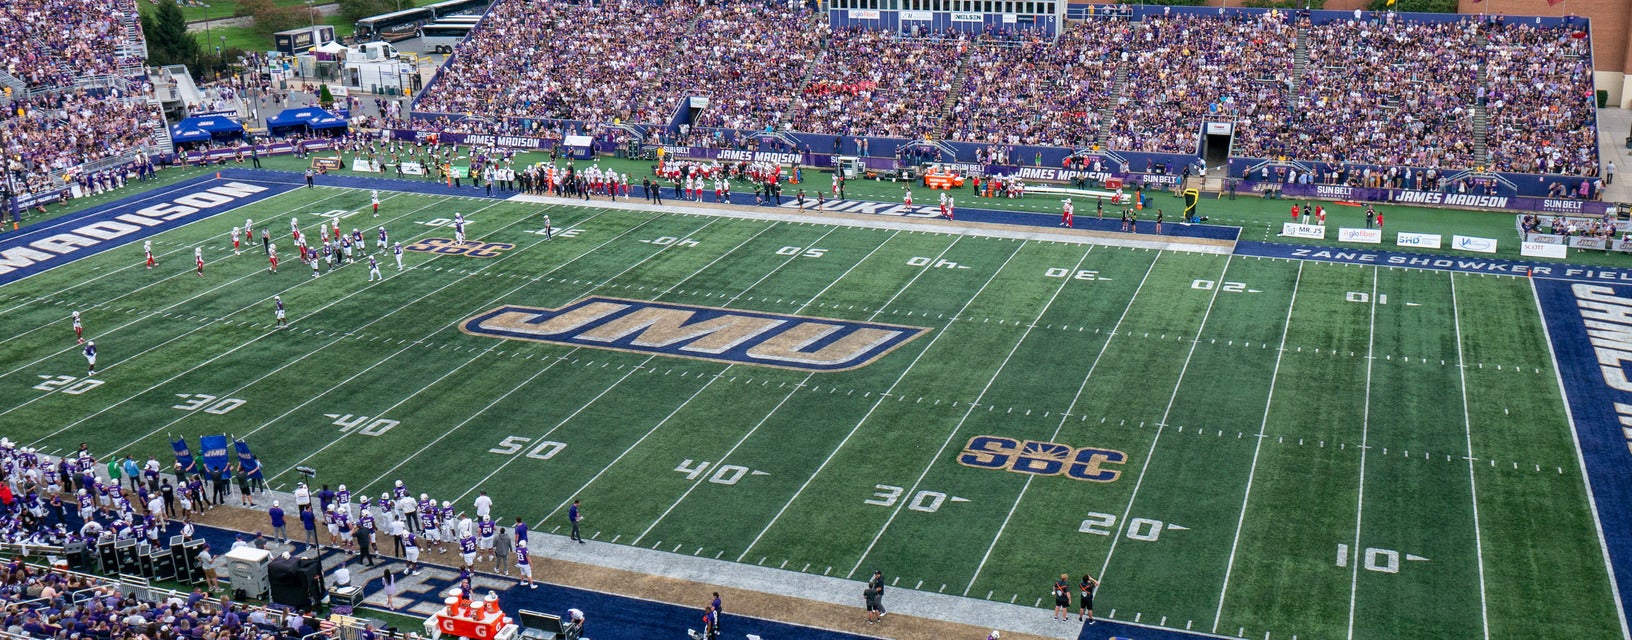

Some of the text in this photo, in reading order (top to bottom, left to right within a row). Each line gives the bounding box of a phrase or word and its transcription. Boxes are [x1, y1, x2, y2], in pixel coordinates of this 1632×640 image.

[464, 134, 540, 148] JAMES MADISON
[717, 150, 802, 164] JAMES MADISON
[1015, 168, 1055, 180] JAMES
[1143, 174, 1176, 184] SUN BELT
[1317, 186, 1334, 194] SUN
[1396, 191, 1508, 208] JAMES MADISON
[1544, 200, 1562, 208] SUN
[0, 181, 270, 275] MADISON
[1291, 248, 1378, 262] ZANE
[1387, 256, 1552, 275] SHOWKER
[474, 300, 908, 367] JMU
[32, 375, 106, 394] 20
[172, 394, 248, 415] 30
[332, 413, 400, 437] 40
[204, 448, 226, 457] JMU
[489, 436, 568, 460] 50
[956, 435, 1128, 483] SBC
[674, 459, 750, 485] 40
[864, 484, 947, 513] 30
[1078, 512, 1163, 542] 20
[1336, 543, 1399, 574] 10
[443, 620, 454, 631] G
[476, 625, 486, 637] G
